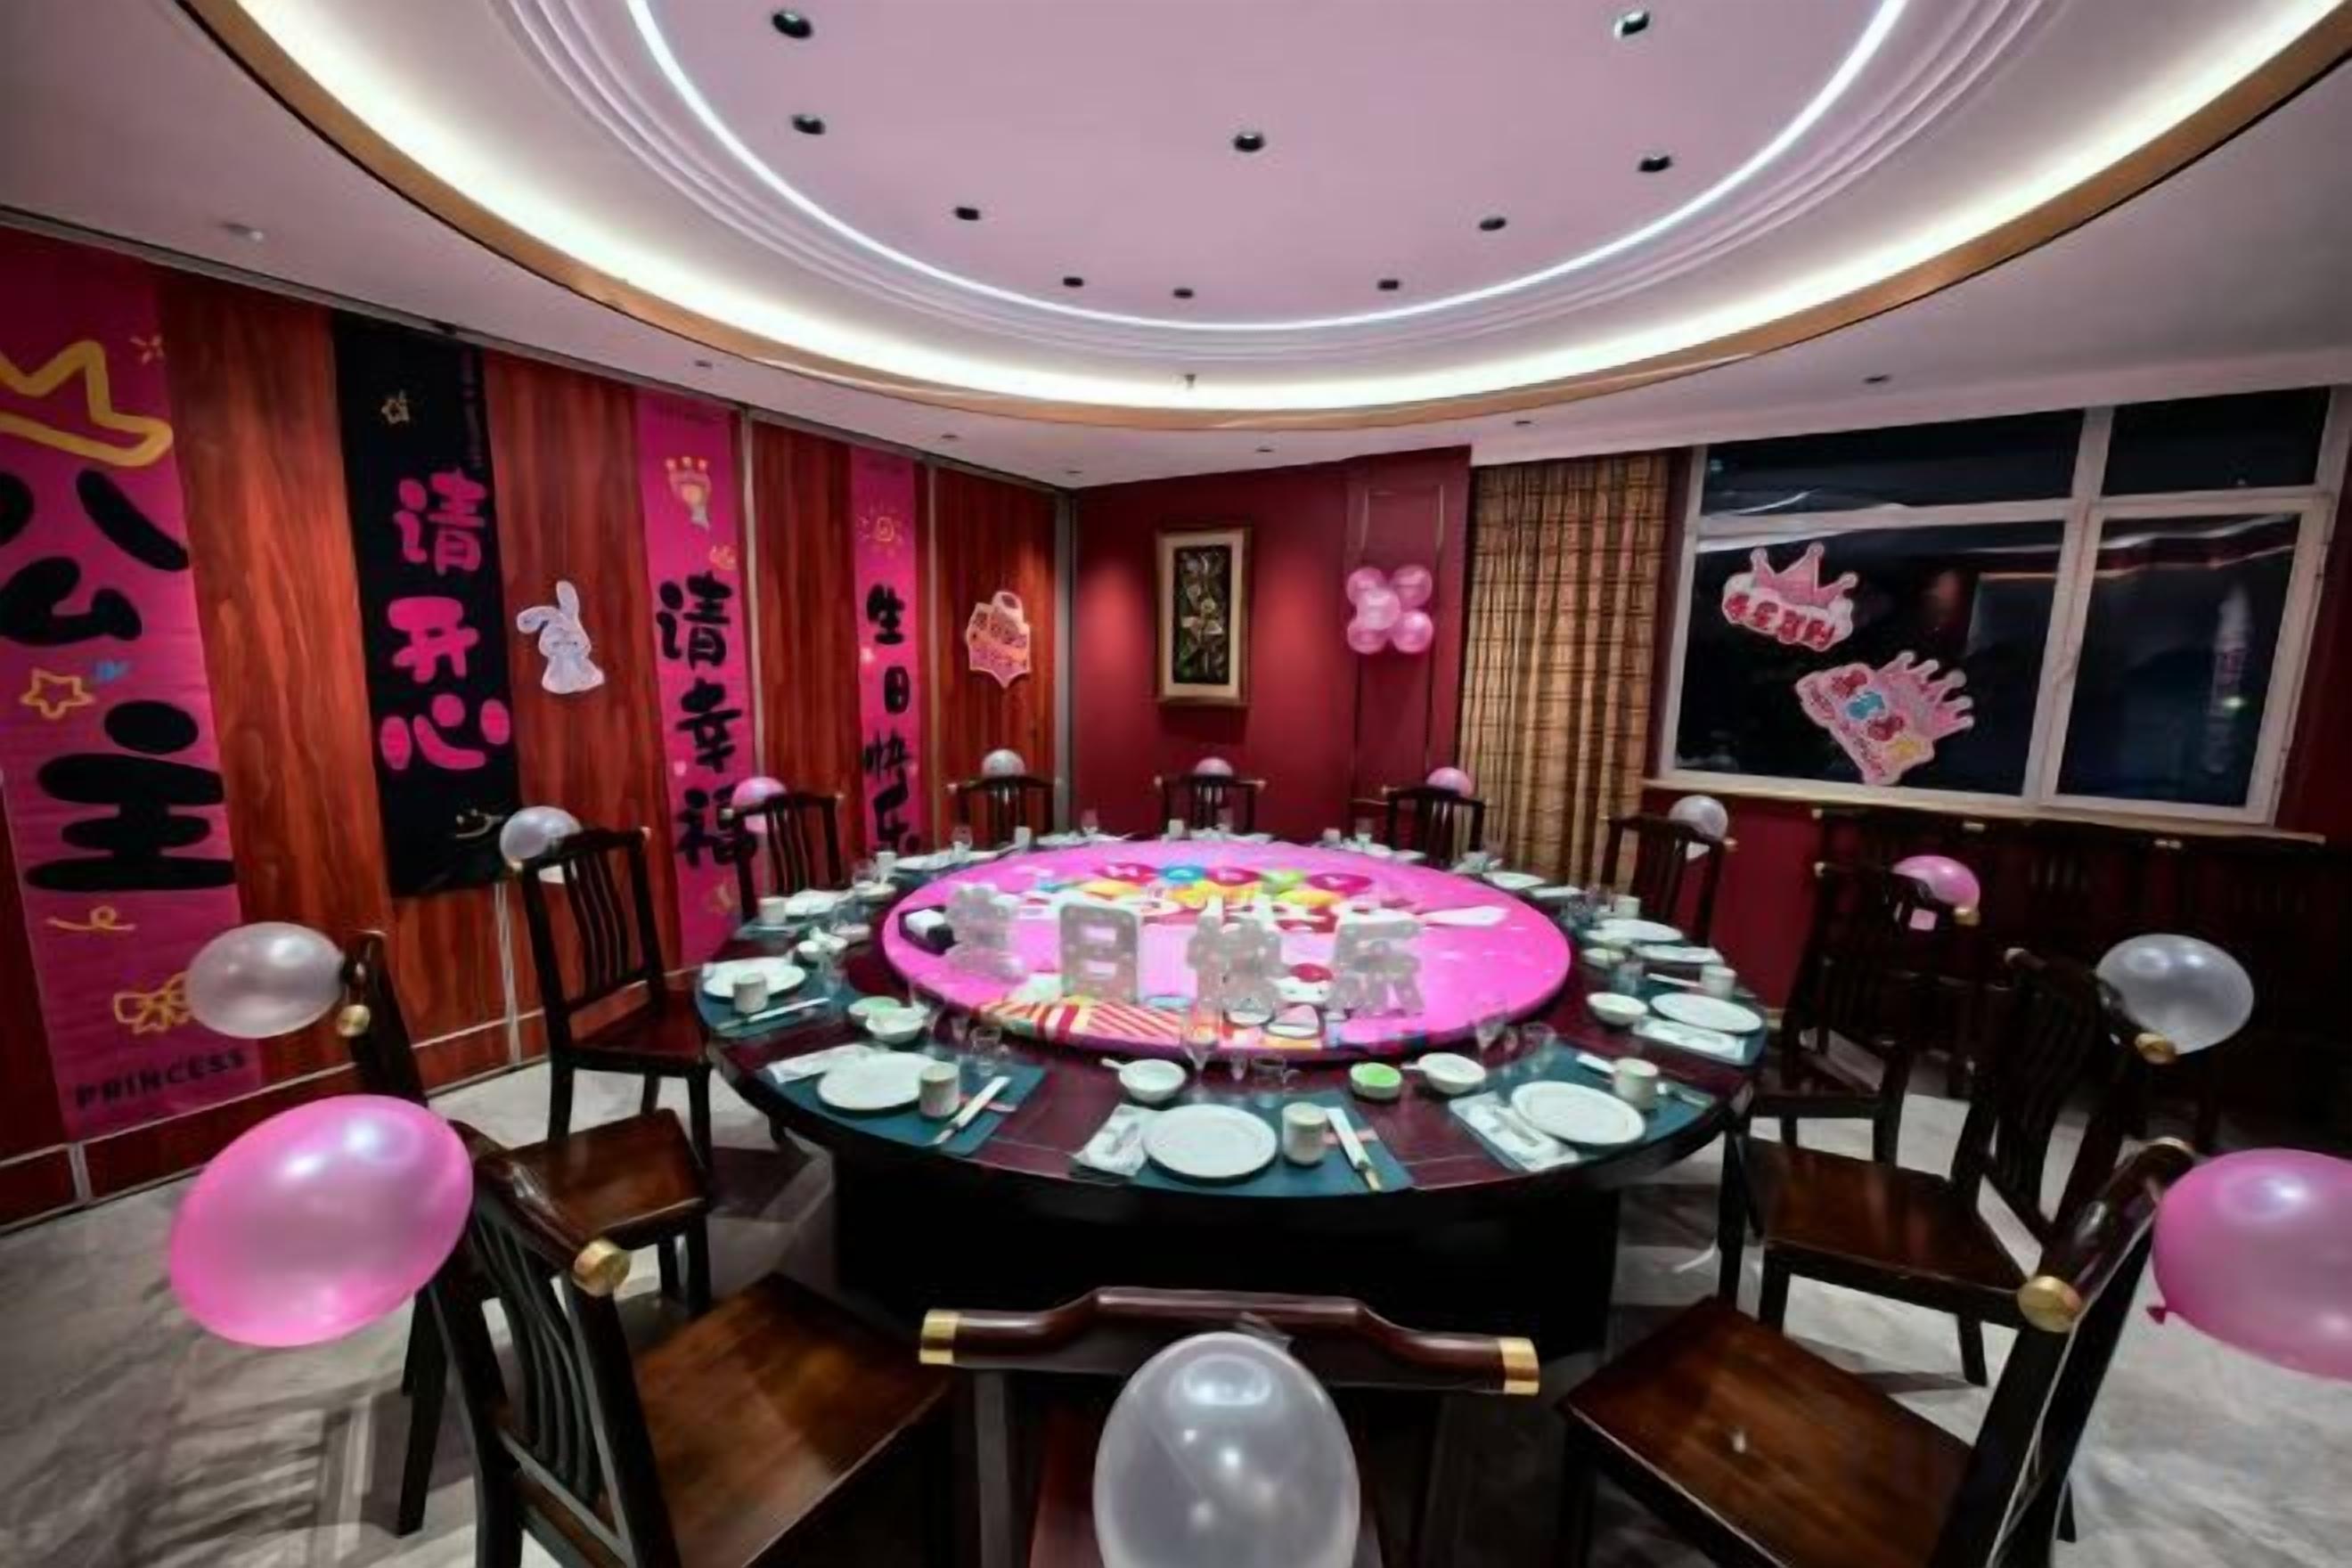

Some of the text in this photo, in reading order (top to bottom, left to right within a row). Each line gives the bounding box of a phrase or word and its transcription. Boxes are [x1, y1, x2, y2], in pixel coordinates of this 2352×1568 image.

[380, 468, 510, 770] 请开心
[656, 571, 757, 869] 请幸福
[861, 583, 921, 855] 生日快乐
